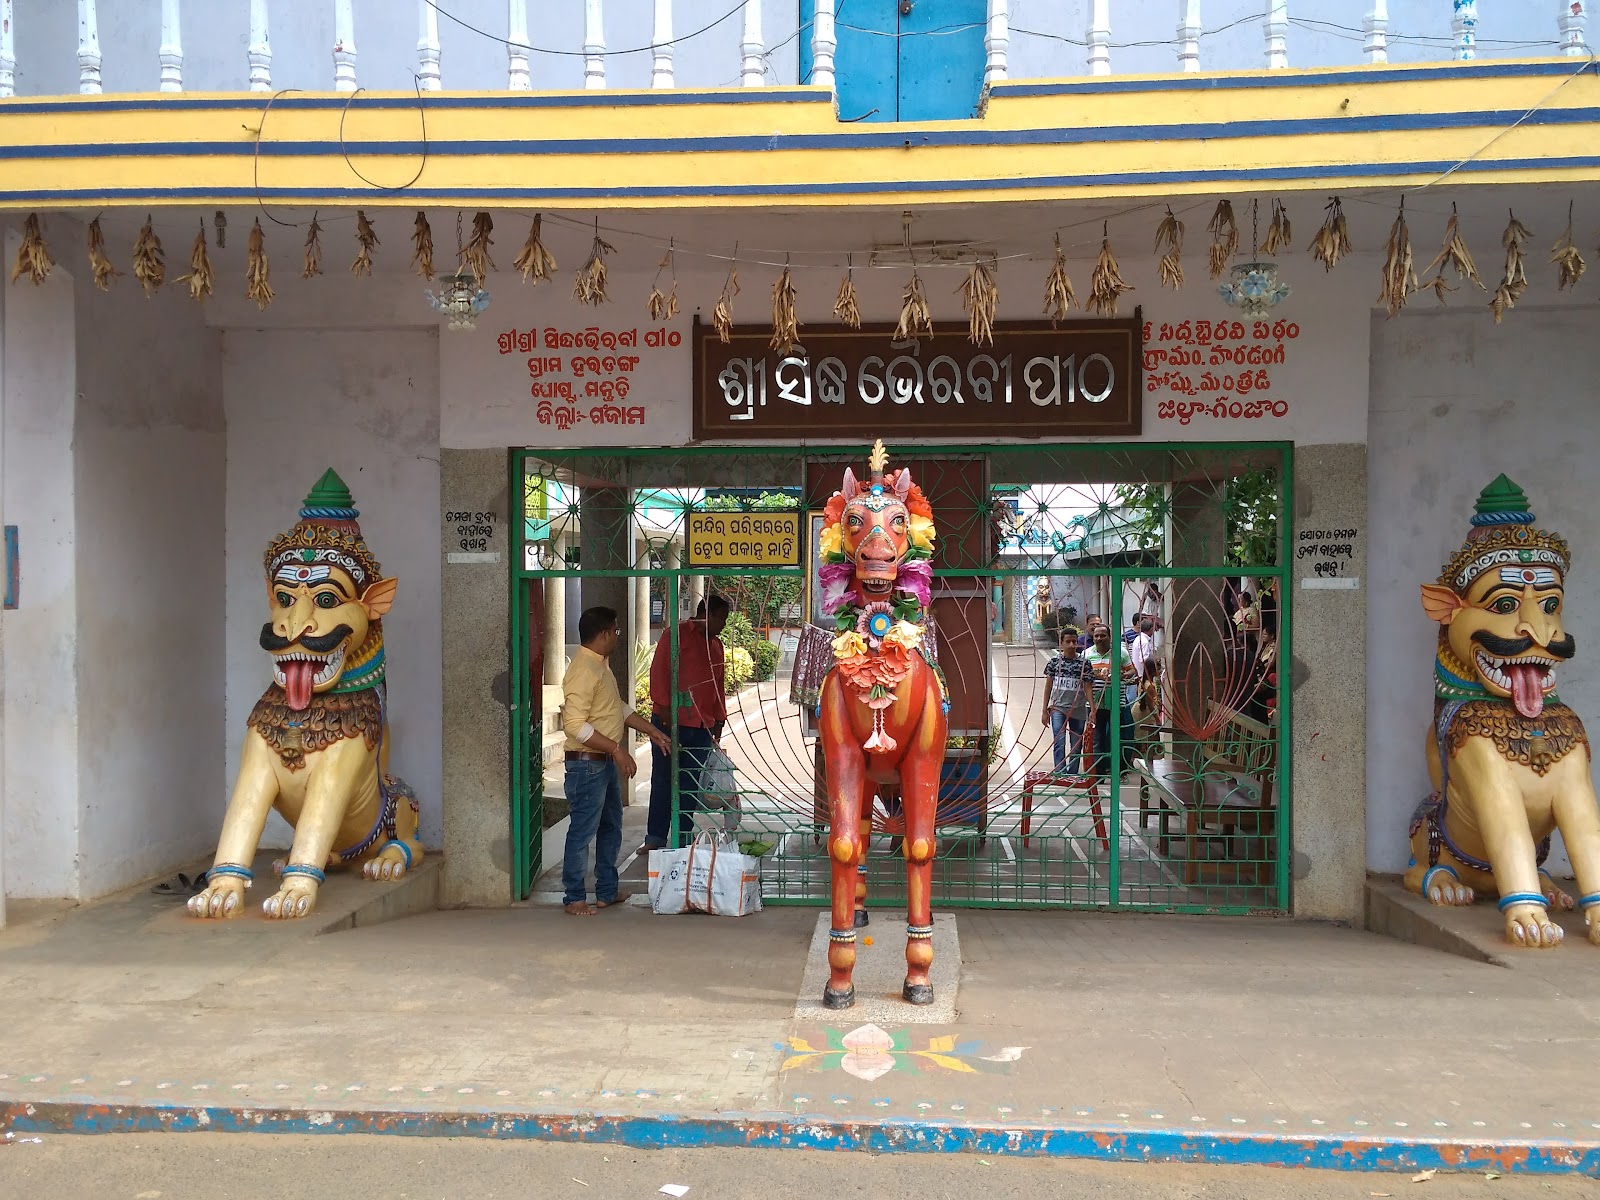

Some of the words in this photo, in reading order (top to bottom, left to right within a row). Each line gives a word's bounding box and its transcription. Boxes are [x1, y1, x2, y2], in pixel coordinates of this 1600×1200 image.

[644, 328, 682, 348] ପୀଠ
[718, 356, 766, 420] ଶ୍ରୀ
[1023, 353, 1115, 406] ପୀଠ
[693, 516, 726, 536] ମନ୍ଦିର
[730, 516, 796, 536] ପରିସରରେ
[768, 538, 795, 560] ନାହିଁ
